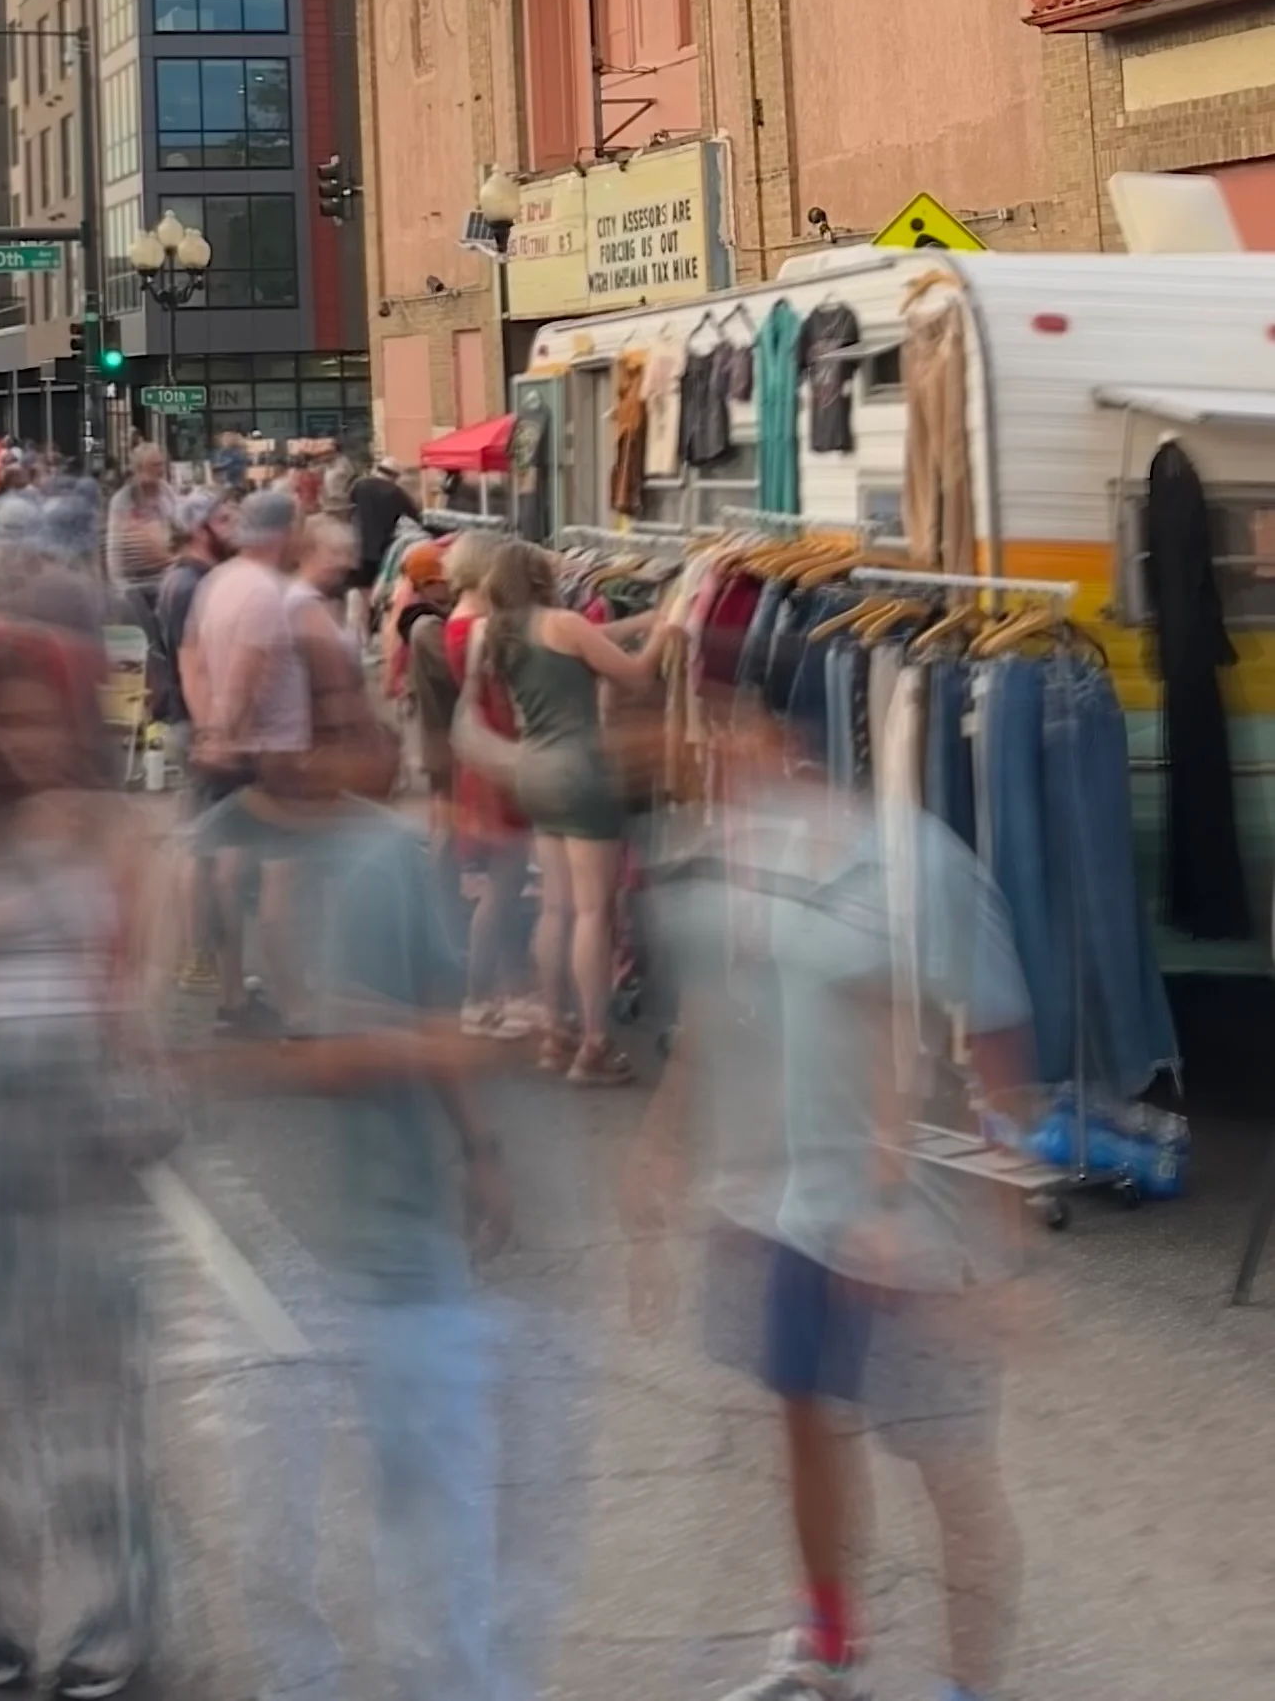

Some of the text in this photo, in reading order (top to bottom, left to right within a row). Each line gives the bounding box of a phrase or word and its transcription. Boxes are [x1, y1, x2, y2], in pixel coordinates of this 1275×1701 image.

[596, 215, 617, 239] CITY
[672, 199, 692, 225] ARE
[600, 230, 679, 265] FORCING US OUT
[651, 262, 669, 284] TAX
[673, 256, 698, 281] HIKE
[158, 390, 186, 403] 10th
[210, 390, 238, 405] UIN
